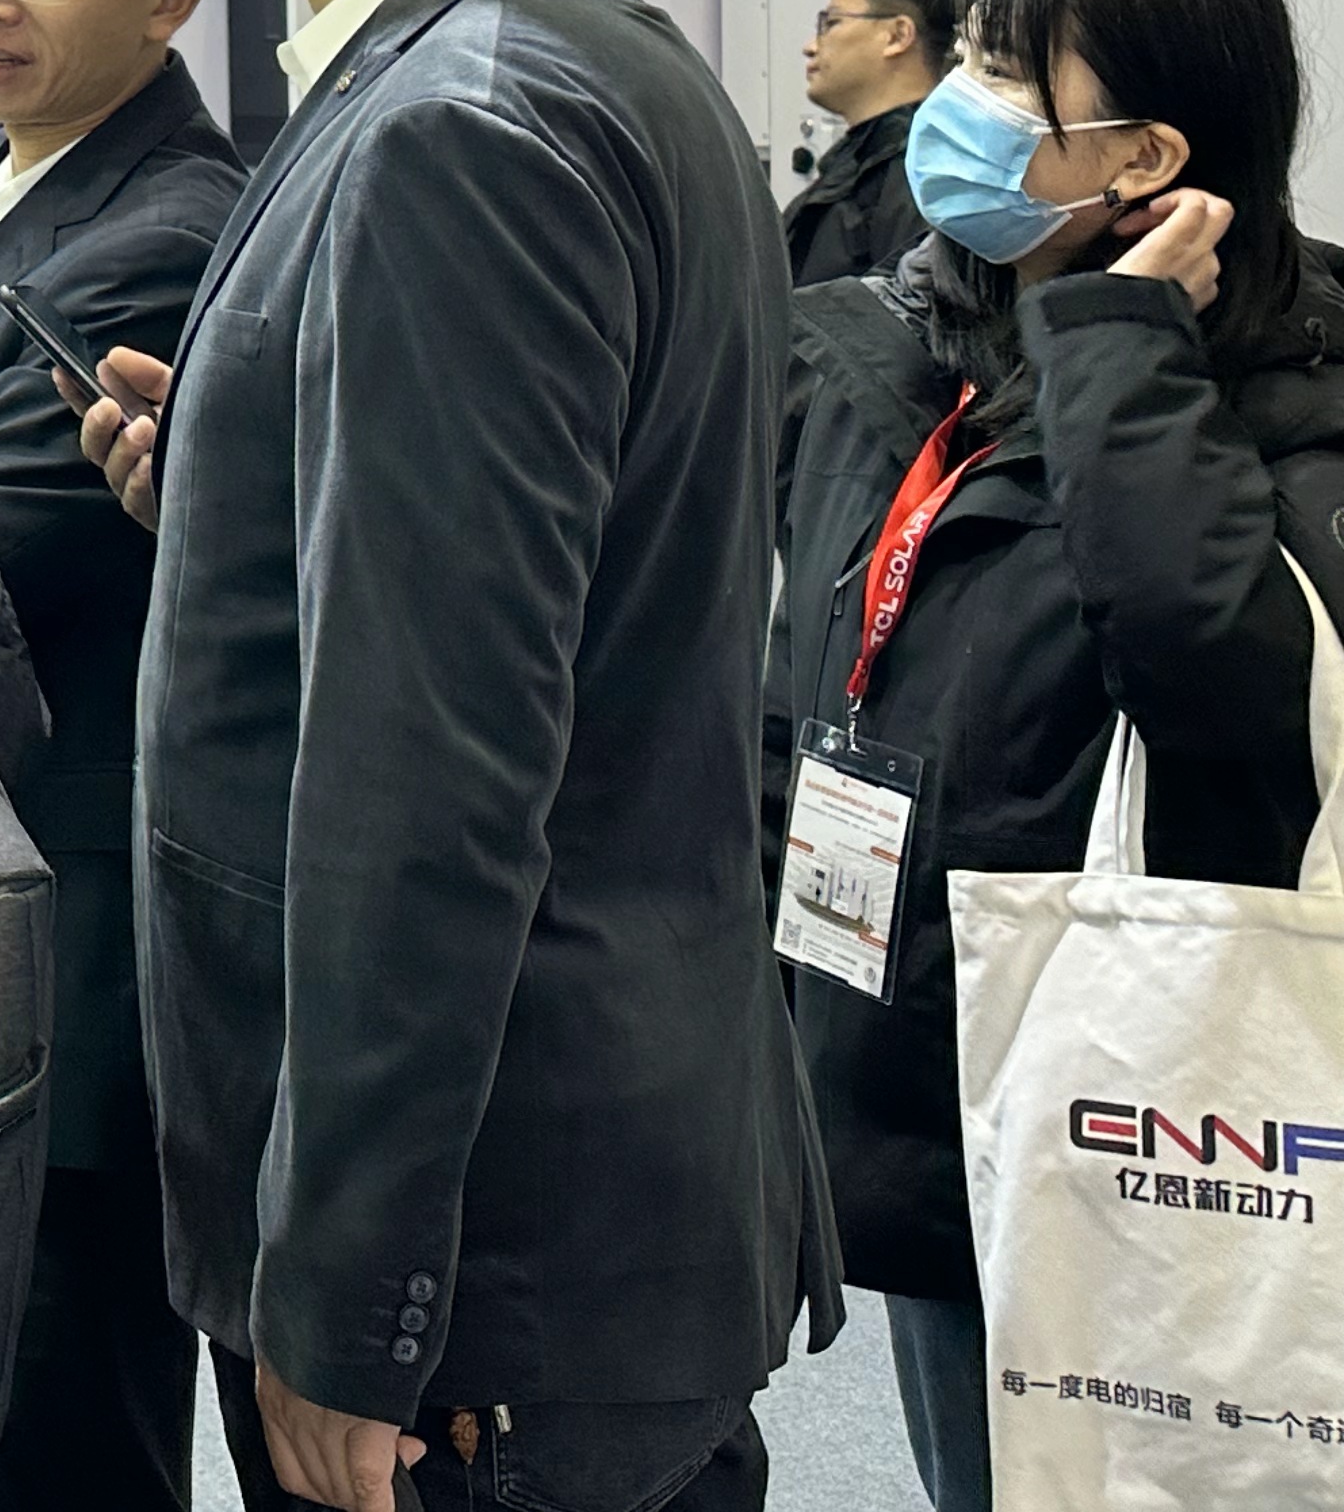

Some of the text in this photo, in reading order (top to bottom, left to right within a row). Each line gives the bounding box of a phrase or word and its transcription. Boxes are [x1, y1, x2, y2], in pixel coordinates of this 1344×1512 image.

[870, 510, 930, 649] TCL SOLAR
[1115, 1167, 1314, 1224] 亿恩新动力
[1001, 1367, 1192, 1422] 每一度电的归宿
